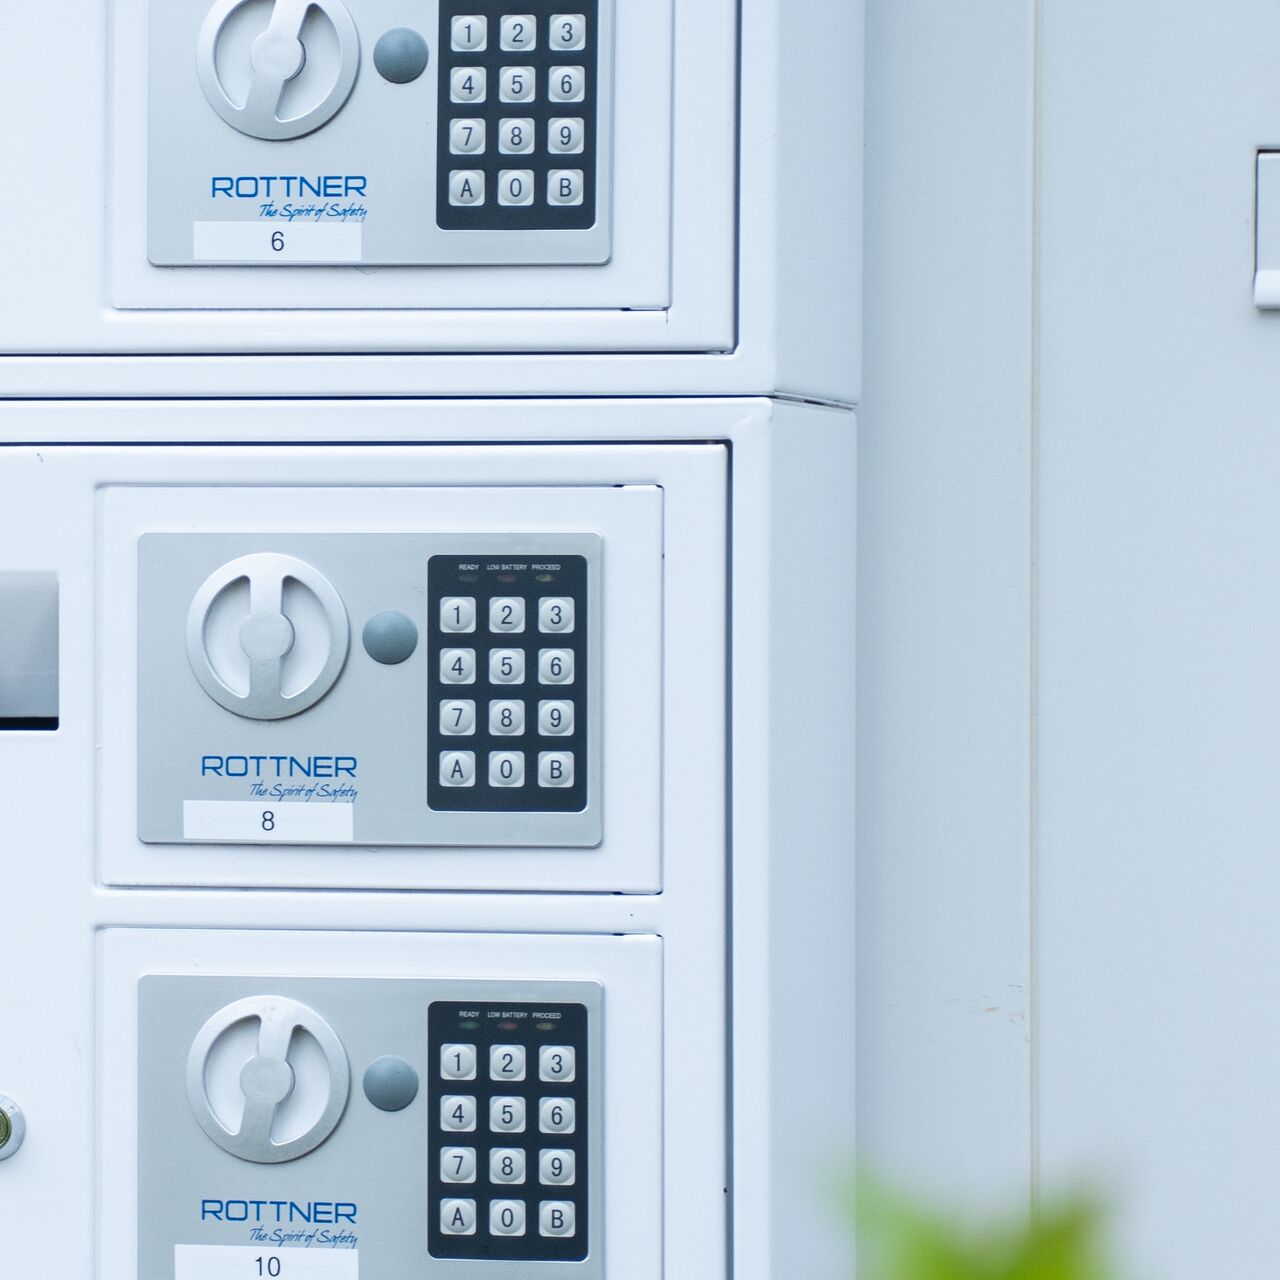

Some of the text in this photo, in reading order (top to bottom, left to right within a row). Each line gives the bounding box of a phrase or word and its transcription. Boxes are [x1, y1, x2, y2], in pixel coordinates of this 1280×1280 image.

[512, 23, 525, 44] 2
[561, 22, 574, 43] 3
[461, 74, 574, 96] 4 5 6
[462, 126, 573, 147] 7 8 9
[212, 176, 366, 197] ROTTNER
[460, 177, 573, 199] A 0 B
[260, 200, 367, 222] The Spirit of Safety
[271, 231, 284, 251] 6
[202, 756, 357, 777] ROTTNER
[250, 780, 358, 802] The Spirit of Safety
[262, 810, 275, 831] 8
[202, 1200, 356, 1224] ROTTNER
[250, 1225, 358, 1249] The Spirit of Safety
[255, 1256, 281, 1277] 10
